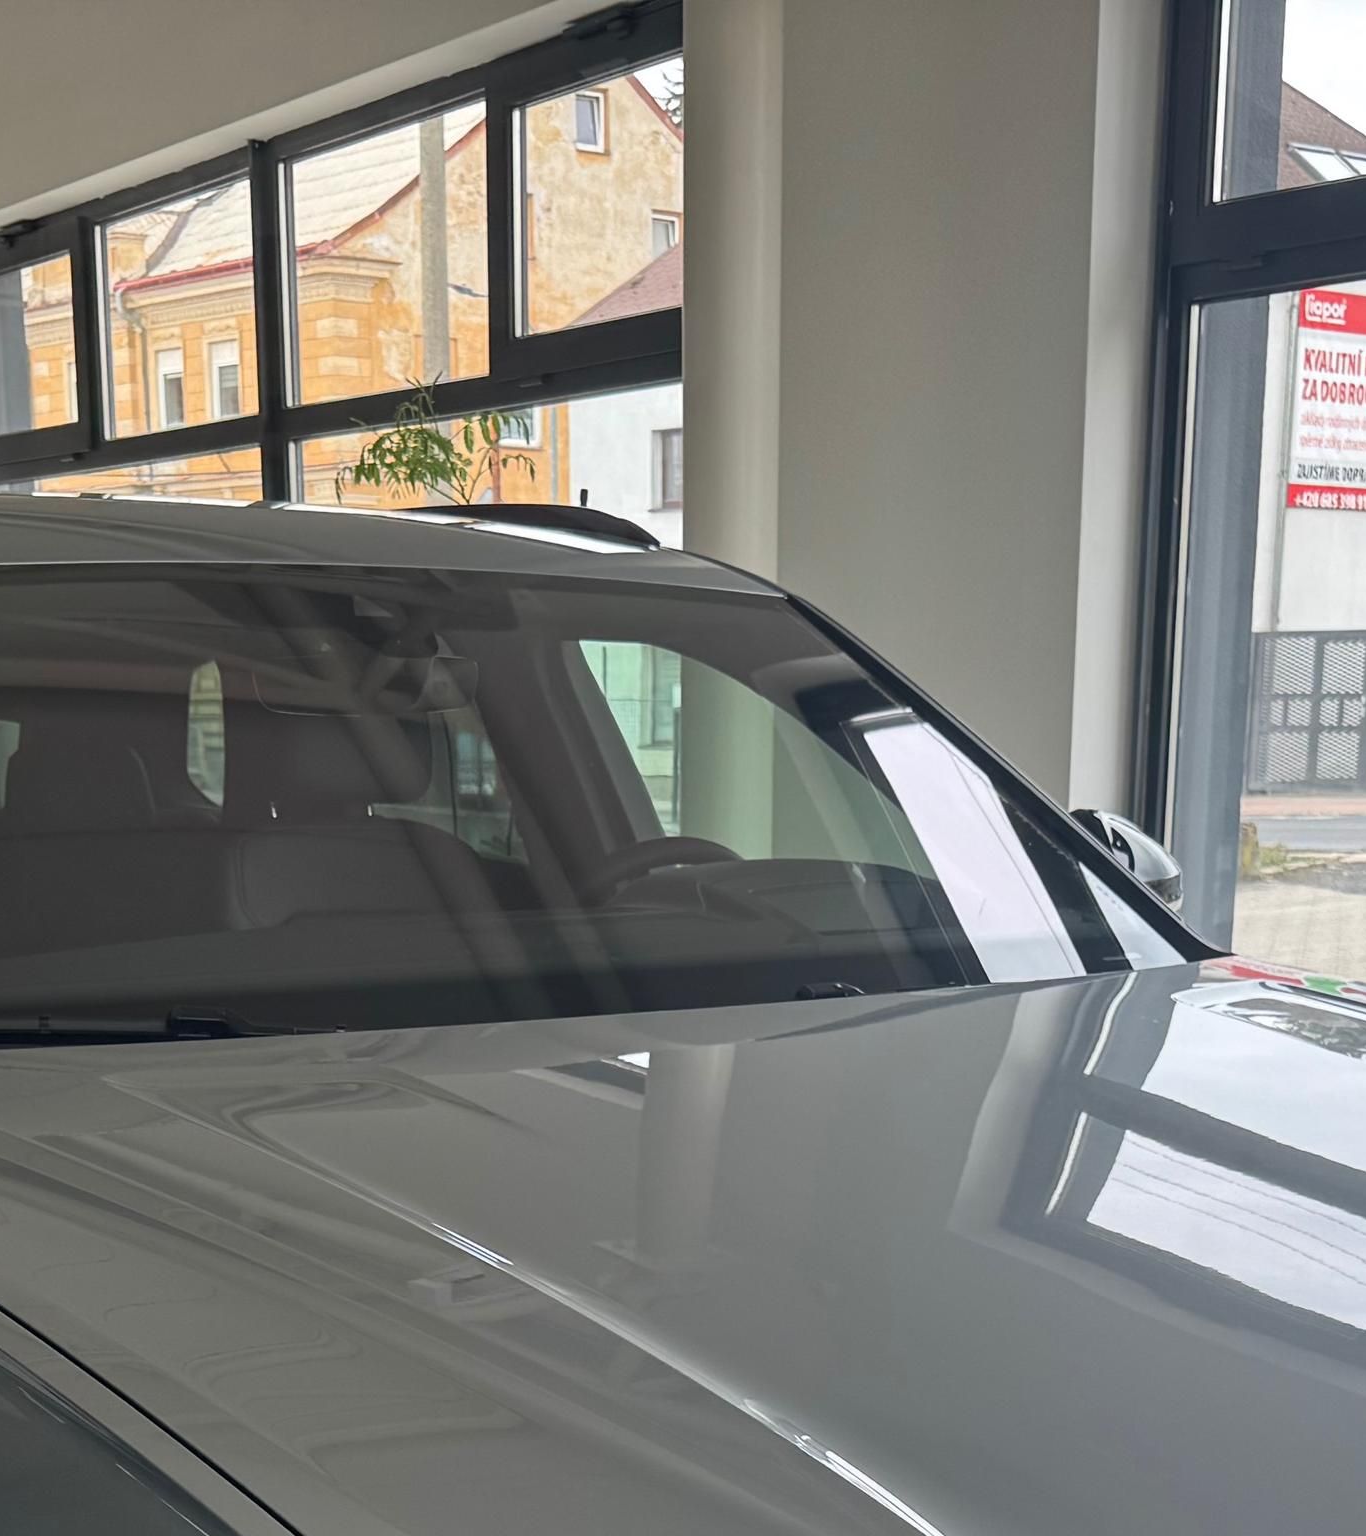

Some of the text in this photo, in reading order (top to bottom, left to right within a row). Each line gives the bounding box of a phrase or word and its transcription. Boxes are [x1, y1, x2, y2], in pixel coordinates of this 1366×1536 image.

[1303, 348, 1363, 377] KVALITNÍ
[1302, 378, 1318, 401] ZA
[1297, 463, 1340, 481] ZAJISTÍME
